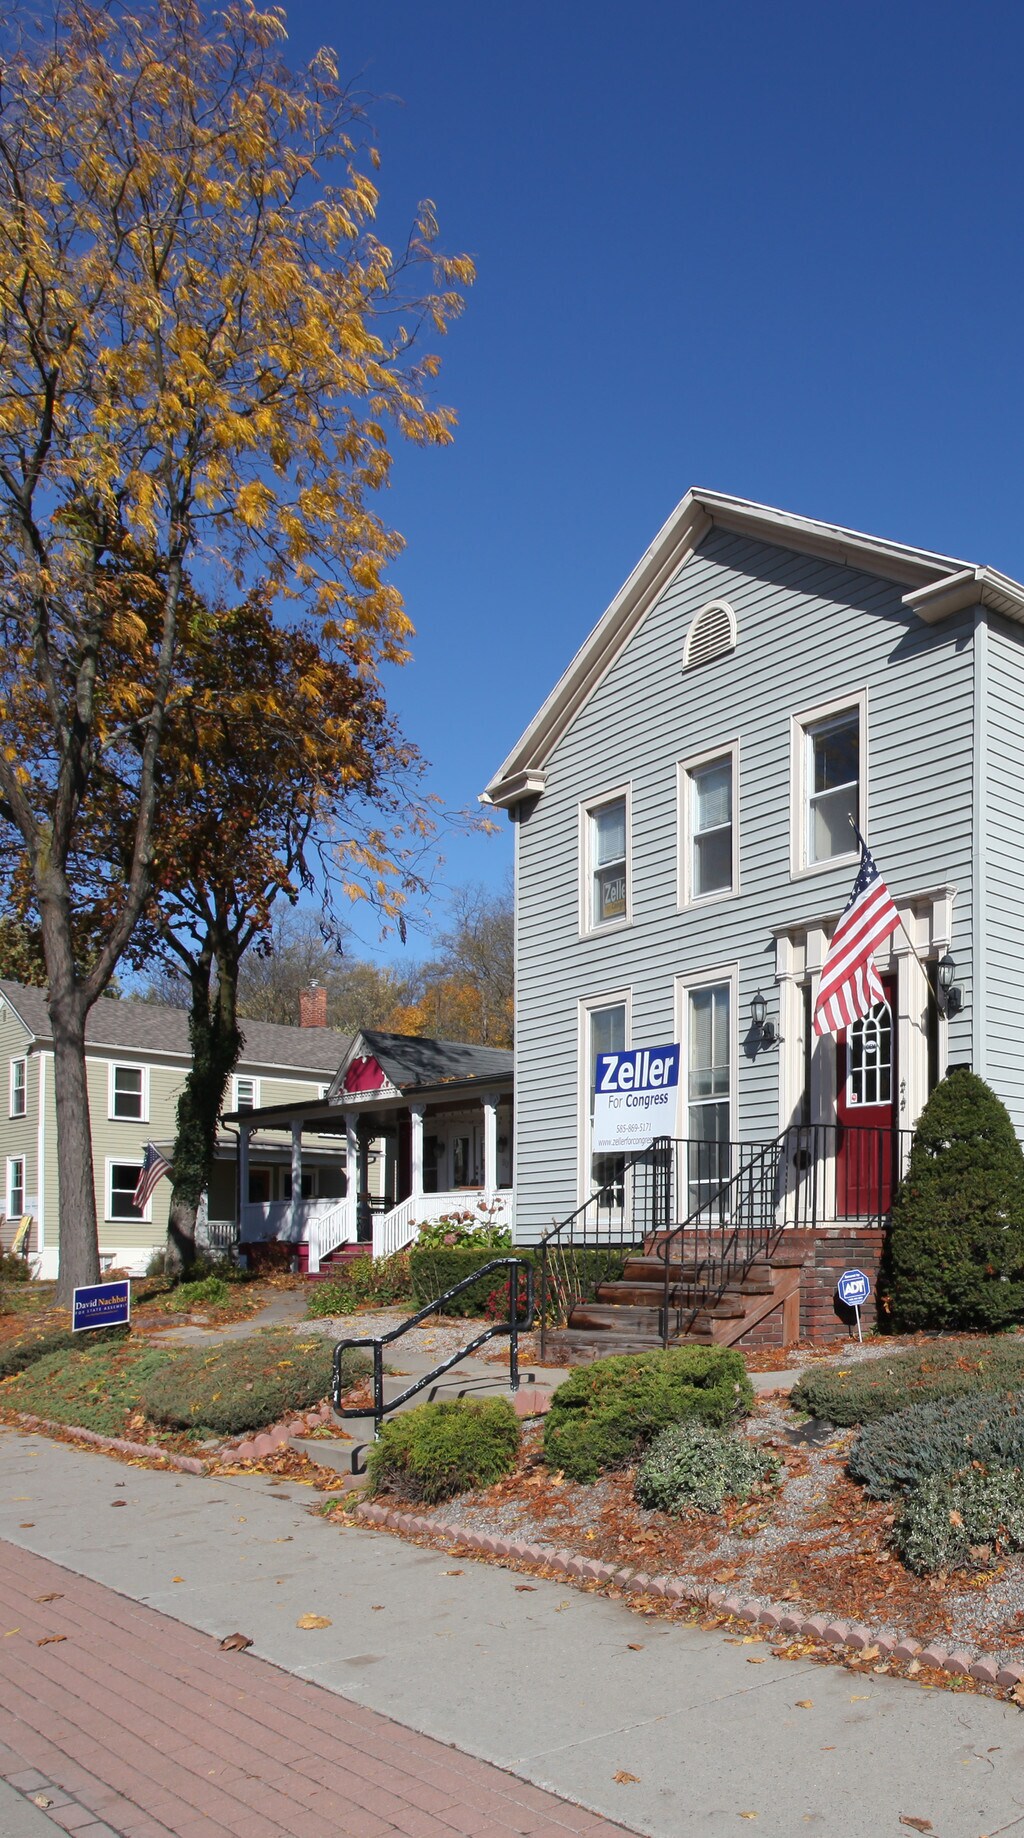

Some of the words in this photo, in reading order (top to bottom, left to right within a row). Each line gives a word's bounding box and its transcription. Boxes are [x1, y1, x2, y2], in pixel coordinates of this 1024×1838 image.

[605, 880, 625, 903] Zelle
[600, 1051, 674, 1091] Zeller
[608, 1095, 623, 1109] For
[625, 1093, 669, 1109] Congress
[845, 1281, 864, 1295] ADT
[76, 1299, 98, 1310] David
